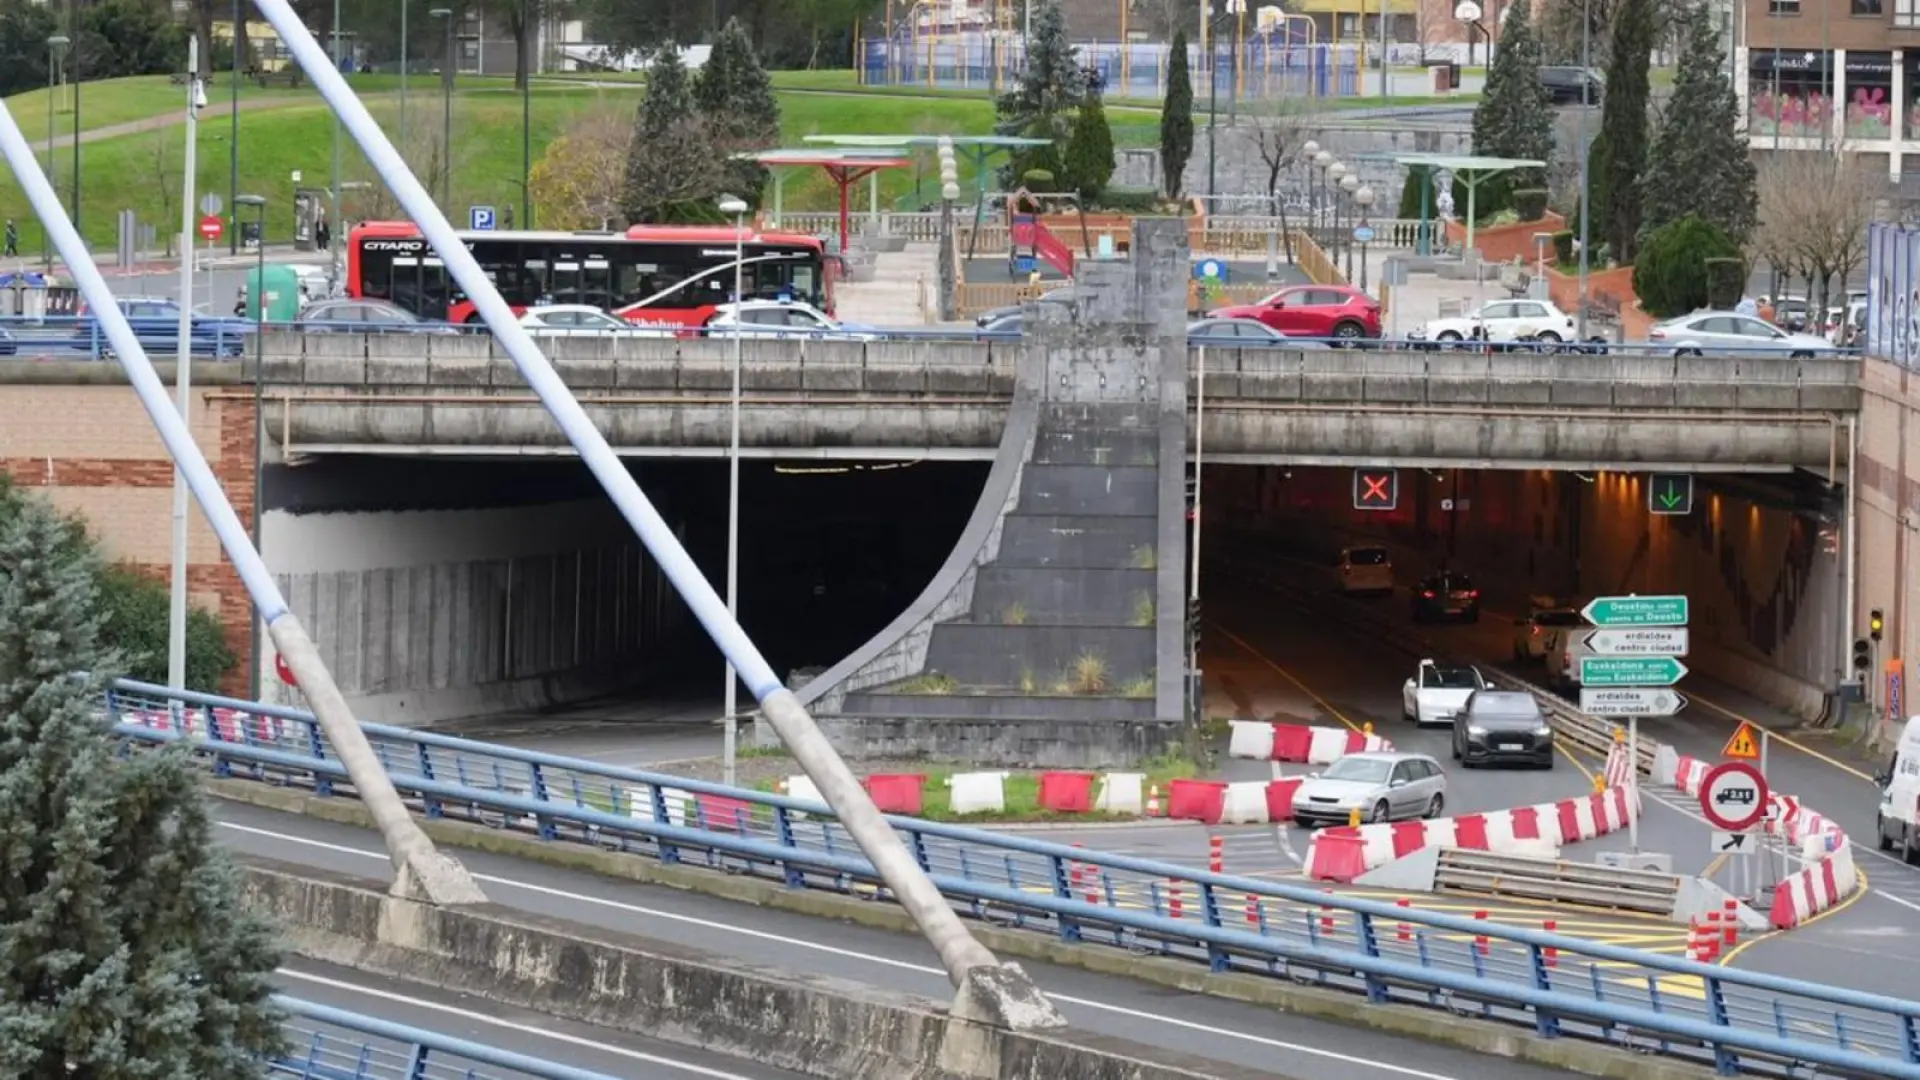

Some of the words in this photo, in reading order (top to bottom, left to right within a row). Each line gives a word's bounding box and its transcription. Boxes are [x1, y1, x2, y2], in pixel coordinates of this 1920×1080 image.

[475, 210, 489, 228] P
[364, 241, 422, 250] CITARO
[1646, 612, 1683, 620] Deusto
[1625, 632, 1672, 640] erdialdea
[1650, 643, 1682, 651] ciudad
[1596, 692, 1641, 700] erdialdea
[1619, 704, 1651, 712] ciudad
